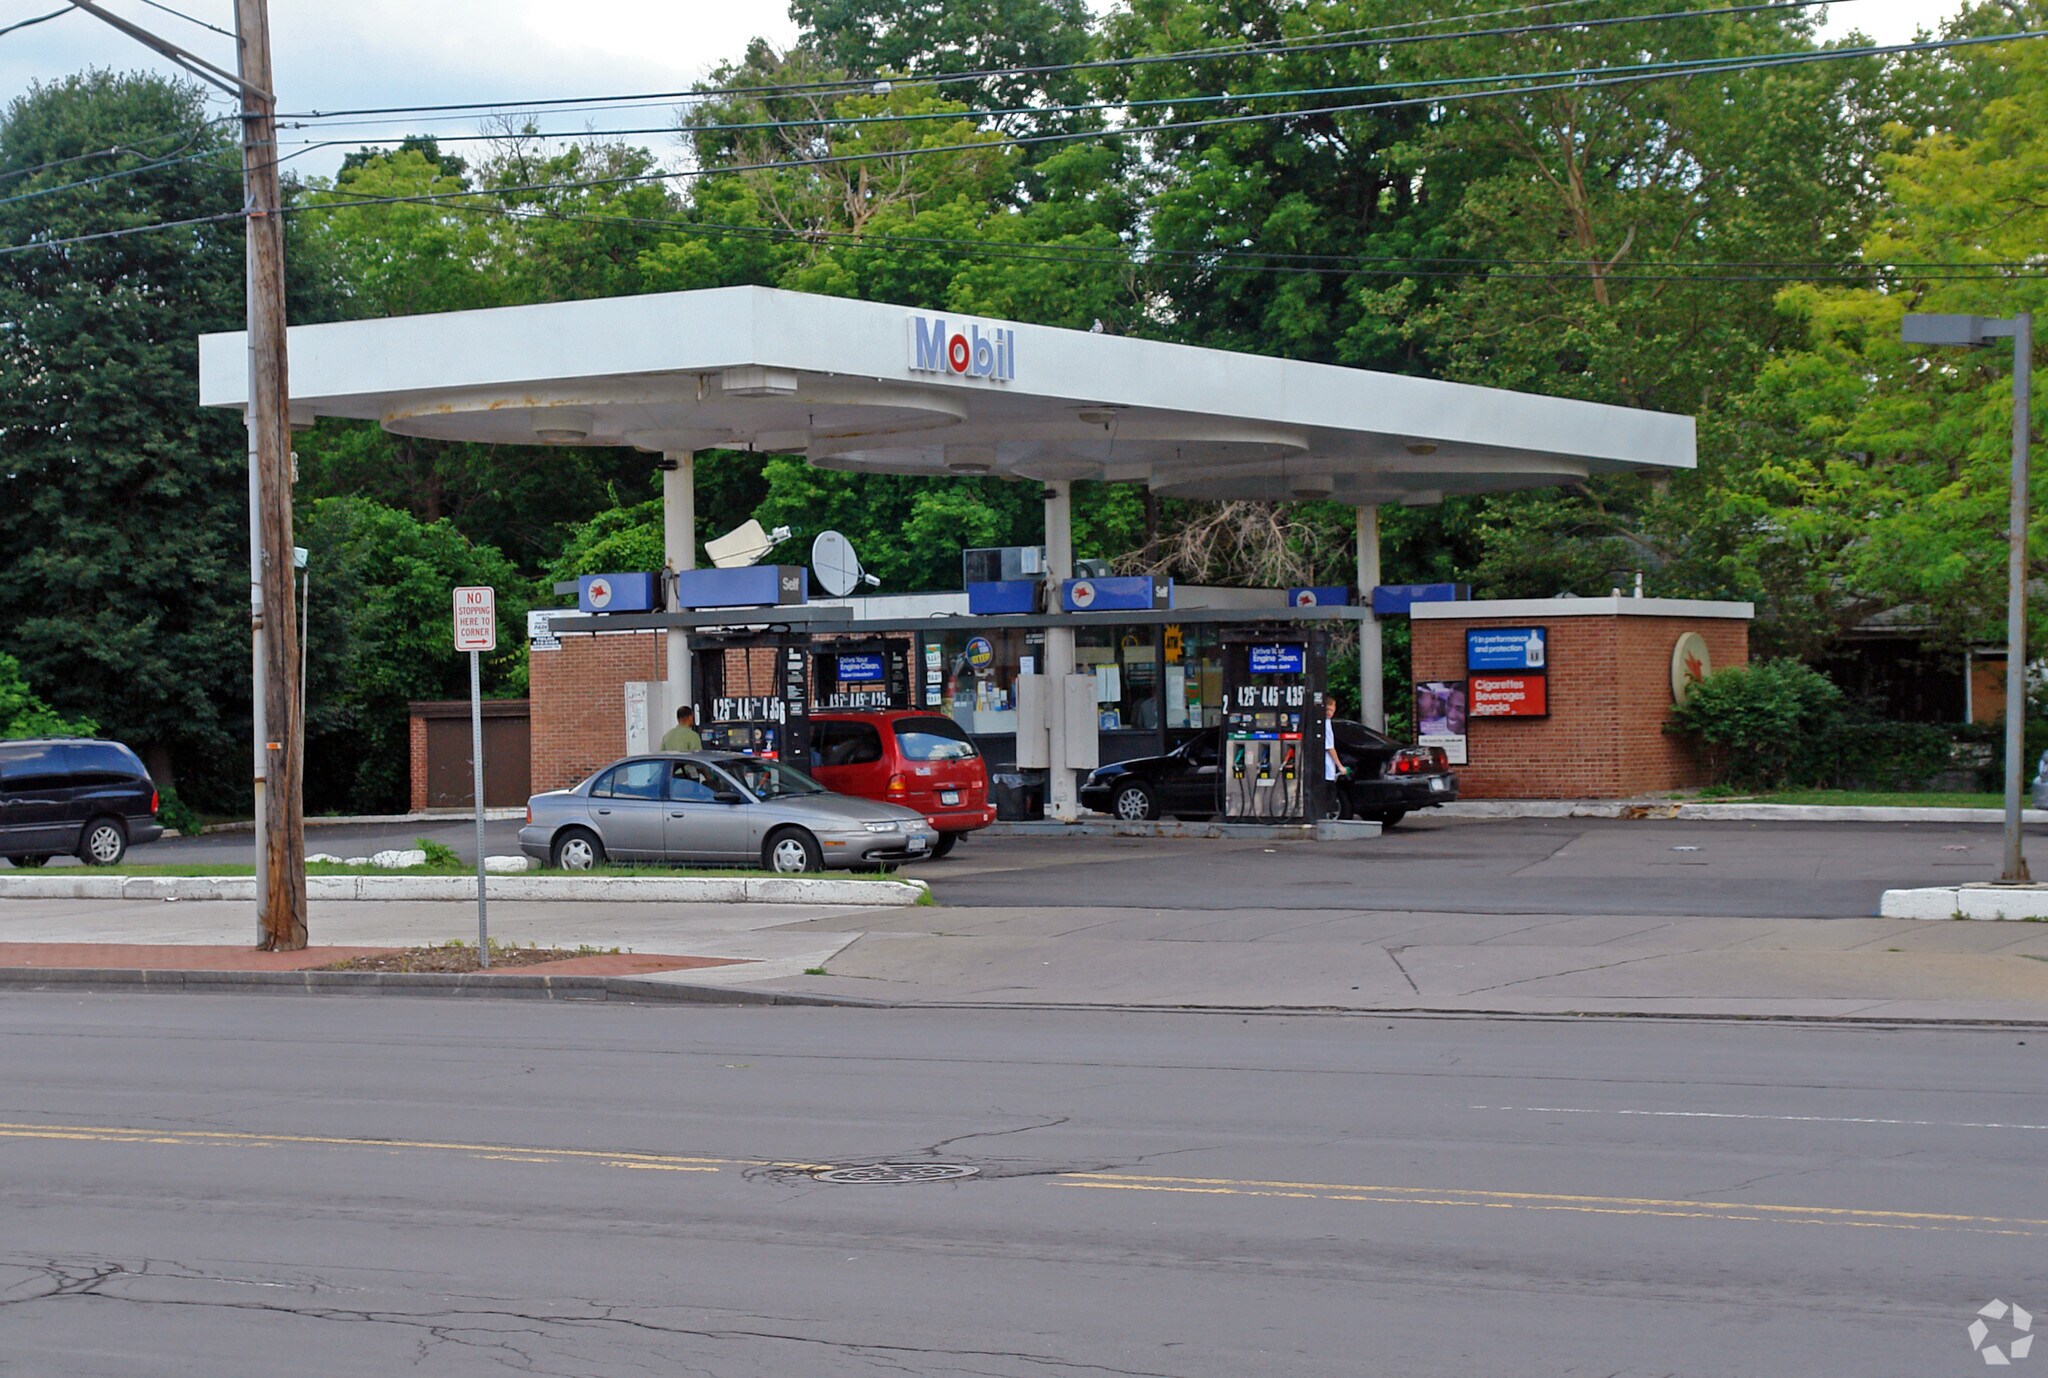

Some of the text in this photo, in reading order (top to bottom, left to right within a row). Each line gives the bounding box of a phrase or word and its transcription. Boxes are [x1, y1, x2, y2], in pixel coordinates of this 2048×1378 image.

[908, 315, 1015, 380] Mobil
[782, 576, 799, 590] Self
[1155, 585, 1168, 598] Self
[467, 592, 482, 604] NO
[459, 606, 490, 615] STOPPING
[460, 616, 490, 626] HERE TO
[461, 628, 490, 637] CORNER
[1485, 635, 1529, 644] performance
[1488, 644, 1523, 653] protection
[1253, 655, 1276, 663] Engine
[840, 663, 861, 672] Engine
[1475, 680, 1524, 692] Cigarettes
[1475, 691, 1525, 702] Beverages
[1223, 694, 1229, 714] 2
[1476, 702, 1510, 712] Snacks
[694, 703, 700, 726] 6
[780, 701, 786, 725] 6
